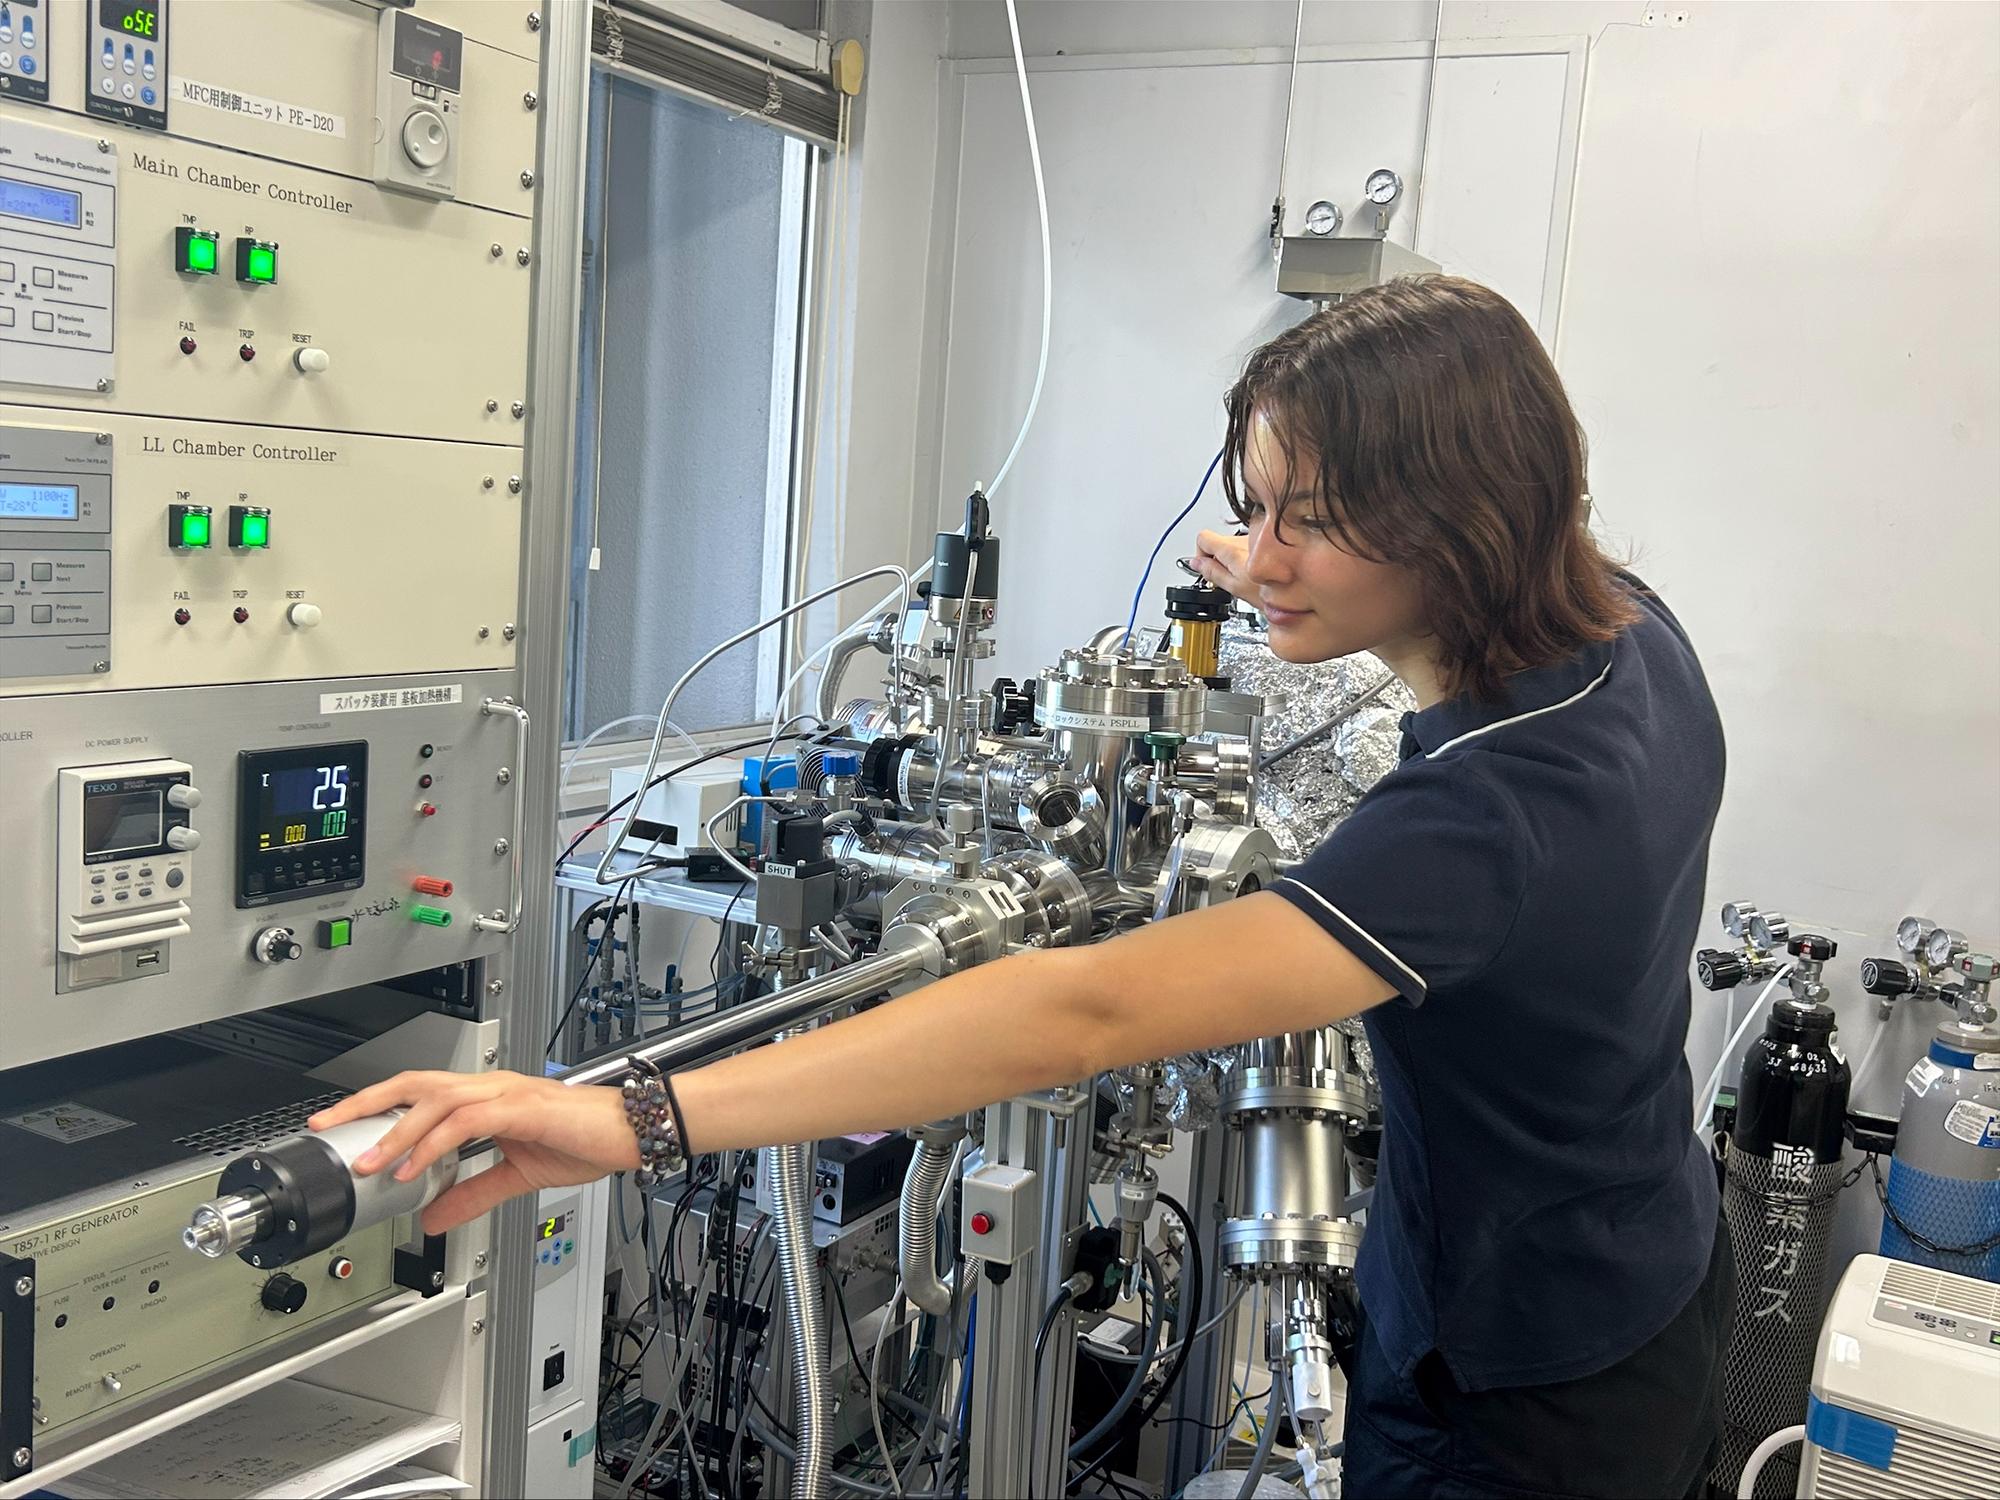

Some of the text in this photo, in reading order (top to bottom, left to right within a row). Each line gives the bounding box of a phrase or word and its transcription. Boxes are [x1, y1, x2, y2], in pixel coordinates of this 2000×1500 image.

[183, 82, 334, 132] MFC用制御ユニット PE-D20
[56, 157, 75, 168] Pump
[77, 162, 111, 175] Controller
[134, 152, 352, 213] Main Chamber Controller
[182, 214, 197, 224] TMP
[244, 225, 254, 235] RP
[15, 292, 33, 300] Menu
[179, 321, 196, 332] FAIL
[239, 329, 255, 339] TRIP
[292, 333, 312, 344] RESET
[143, 436, 337, 462] LL Chamber Controller
[176, 491, 190, 500] TMP
[239, 493, 248, 502] RP
[174, 591, 190, 600] FAIL
[233, 590, 248, 599] TRIP
[286, 590, 305, 599] RESET
[335, 692, 397, 711] スパッタ装置用
[1110, 719, 1140, 729] PSPLL
[85, 736, 149, 748] DC POWER SUPPLY
[87, 784, 118, 793] TEXIO
[313, 765, 347, 810] 25
[322, 810, 347, 837] 100
[768, 865, 792, 876] SHUT
[13, 1205, 140, 1254] T857-1 RF GENERATOR
[544, 1217, 555, 1238] 2
[1754, 1142, 1815, 1323] 酸素ガス
[50, 1238, 81, 1254] DESIGN
[83, 1272, 106, 1285] STATUS
[92, 1275, 127, 1292] OVER HEAT
[54, 1296, 69, 1306] FUSE
[89, 1342, 126, 1361] OPERATION
[122, 1363, 141, 1375] LOCAL
[65, 1383, 92, 1398] REMOTE
